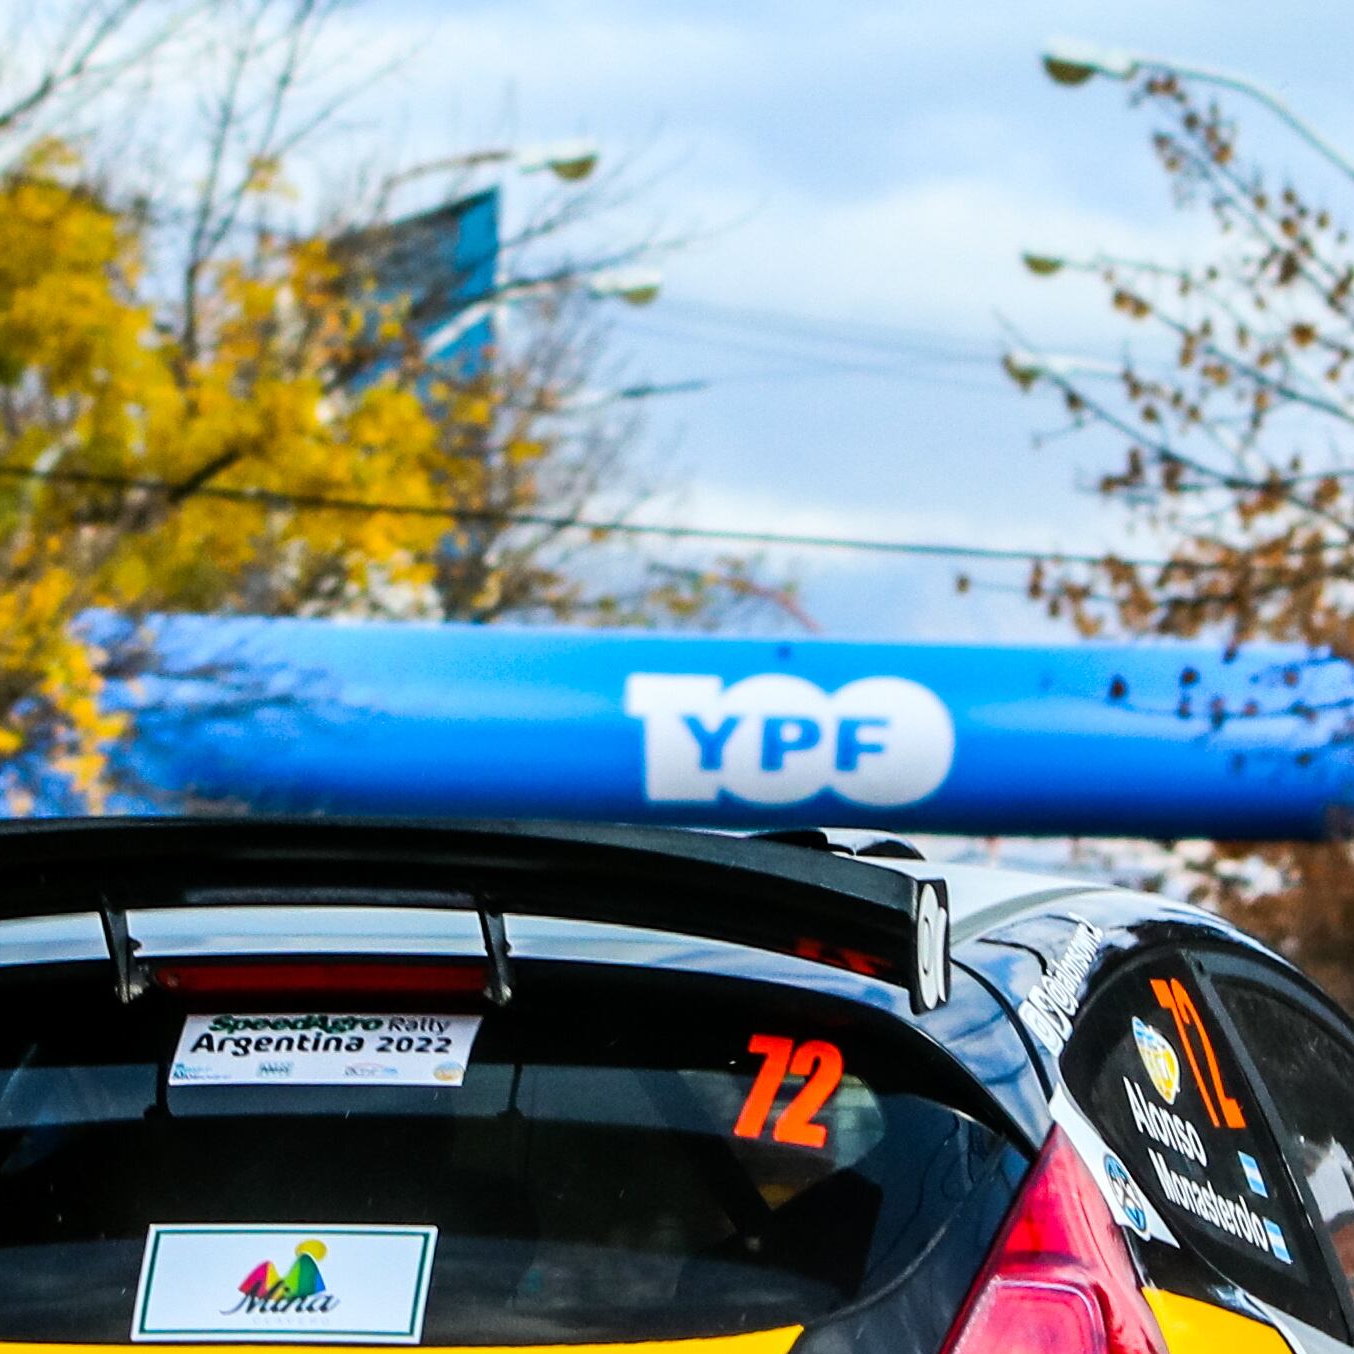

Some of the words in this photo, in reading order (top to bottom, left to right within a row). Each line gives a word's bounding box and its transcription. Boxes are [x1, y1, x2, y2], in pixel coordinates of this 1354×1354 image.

[680, 714, 889, 773] YPF
[190, 1030, 365, 1057] Argentina
[375, 1035, 453, 1054] 2022
[208, 1013, 384, 1034] SpeedAgro
[387, 1015, 451, 1034] Rally
[1150, 978, 1246, 1129] 72
[733, 1033, 845, 1149] 72
[1123, 1075, 1208, 1168] Alonso
[1147, 1147, 1270, 1252] Monasterolo
[219, 1279, 341, 1316] Mina
